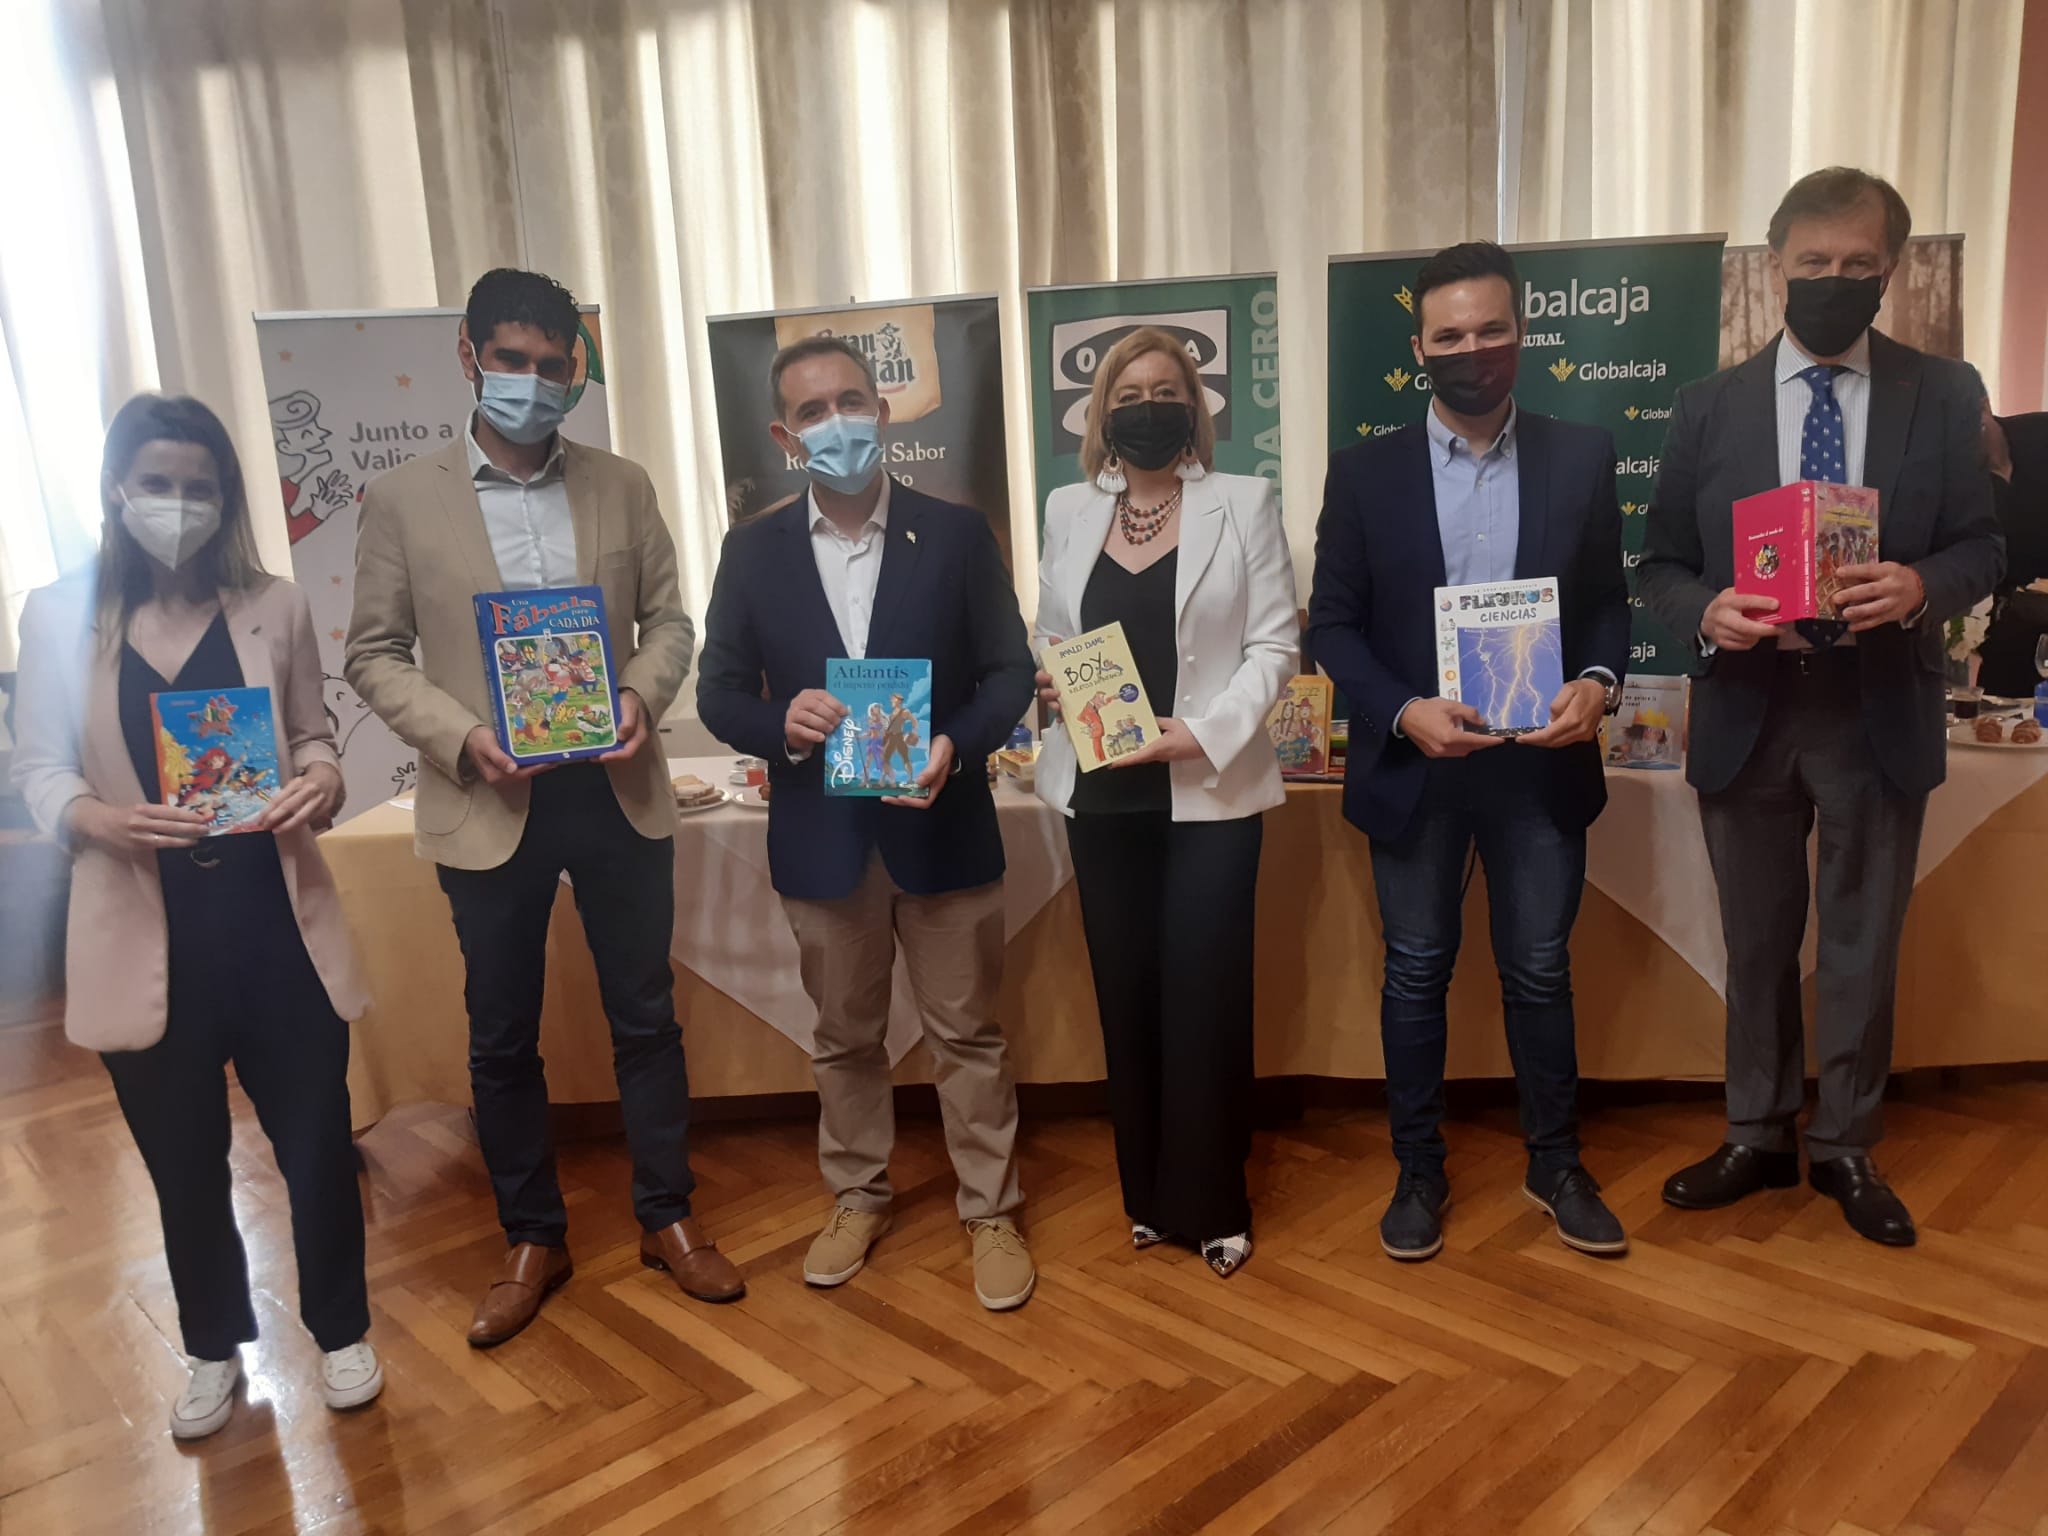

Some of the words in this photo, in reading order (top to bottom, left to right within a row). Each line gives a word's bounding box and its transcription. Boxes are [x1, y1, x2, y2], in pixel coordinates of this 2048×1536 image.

[1251, 290, 1280, 410] CERO
[1579, 359, 1667, 383] Globalcaja
[349, 420, 429, 443] Junto
[439, 423, 454, 439] a
[891, 441, 946, 463] Sabor
[549, 616, 579, 629] CADA
[1480, 607, 1537, 623] CIENCIAS
[834, 665, 909, 679] Atlantis
[1064, 651, 1102, 686] BOY
